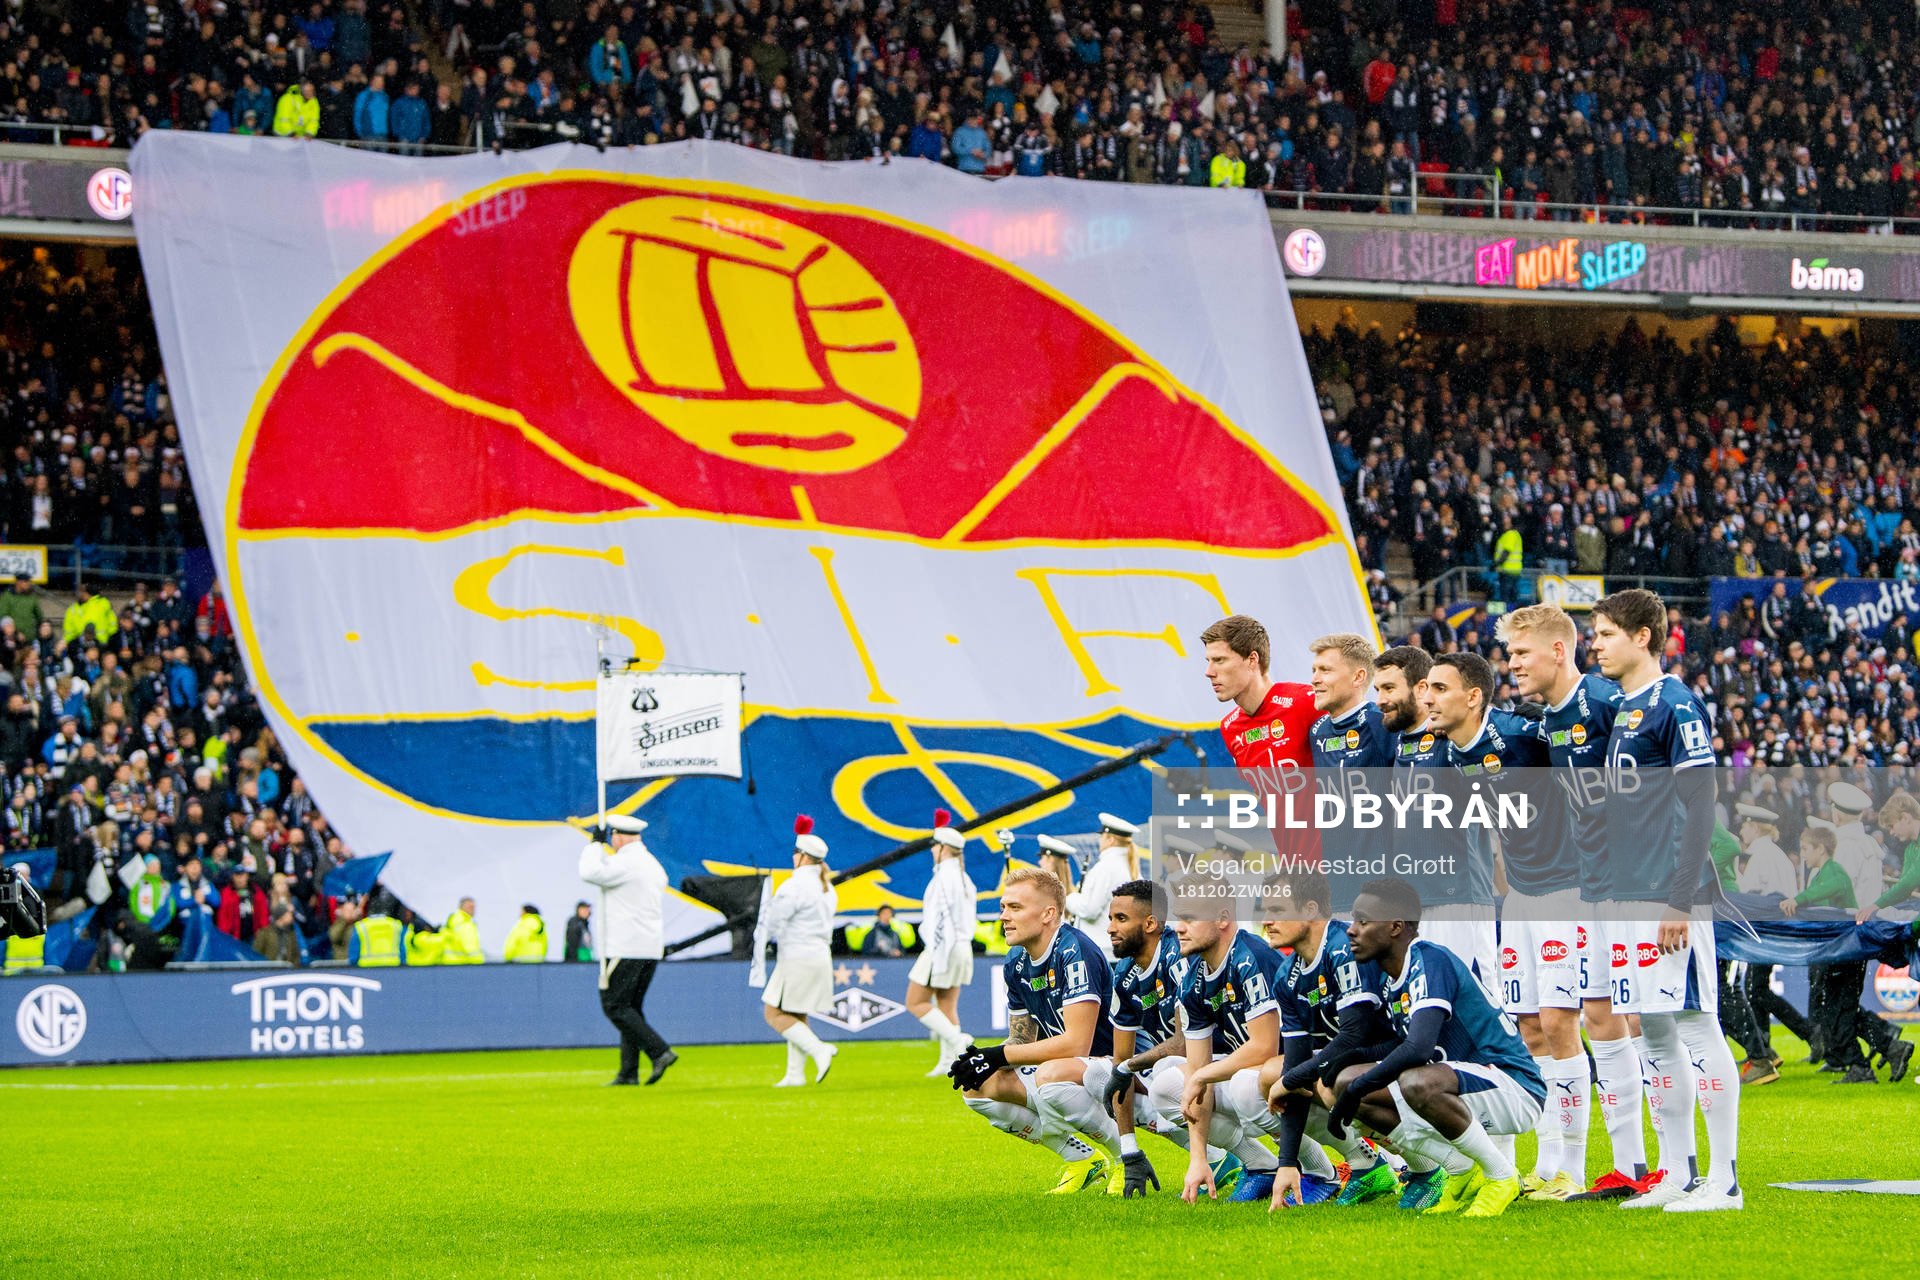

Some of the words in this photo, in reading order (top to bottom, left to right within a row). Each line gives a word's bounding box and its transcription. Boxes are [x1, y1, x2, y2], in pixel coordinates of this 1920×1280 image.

[1476, 237, 1517, 286] EAT
[1516, 237, 1580, 290] MOVE
[1581, 240, 1647, 291] SLEEP
[1791, 258, 1864, 292] bama
[1541, 945, 1569, 960] ARBO
[1612, 950, 1628, 961] RBO
[1637, 948, 1660, 959] RBO
[1580, 957, 1589, 989] 5
[231, 973, 382, 1022] THON
[1611, 978, 1630, 1005] 26
[251, 1025, 364, 1051] HOTELS
